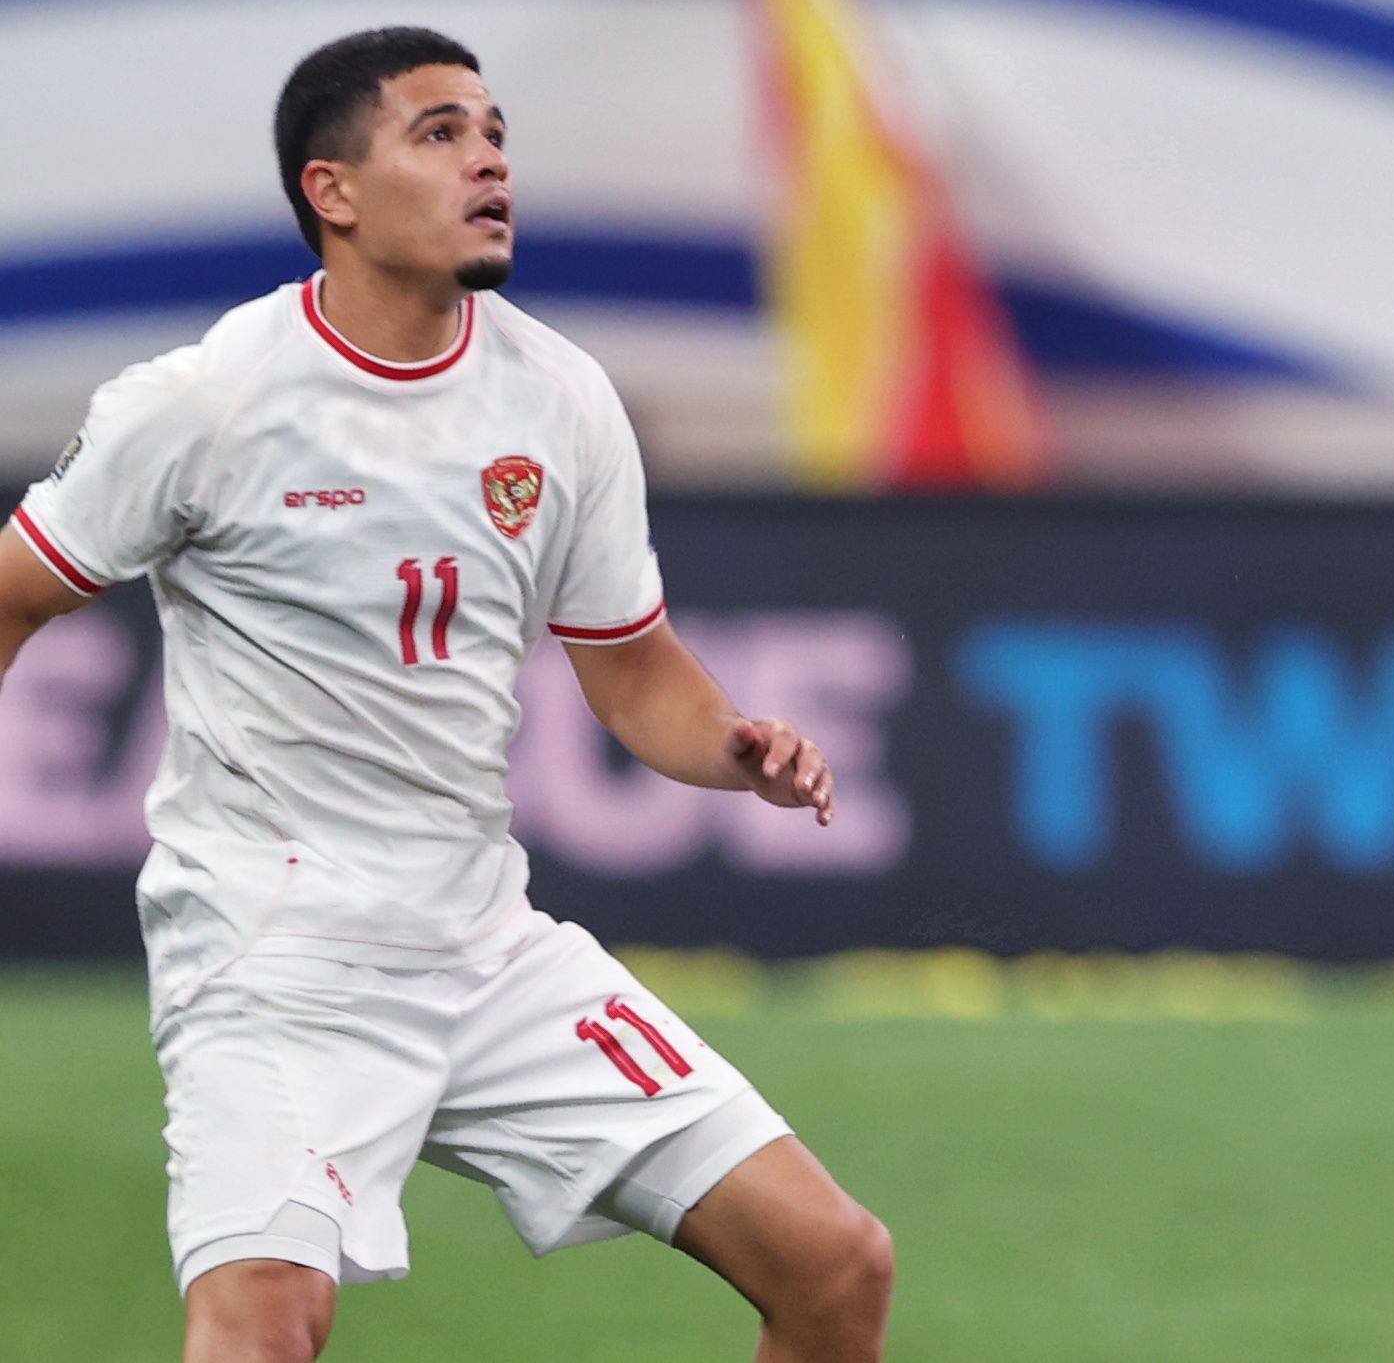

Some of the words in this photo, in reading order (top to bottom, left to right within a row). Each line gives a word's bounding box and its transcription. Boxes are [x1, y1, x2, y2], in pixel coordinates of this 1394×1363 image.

[284, 488, 366, 511] erspo
[396, 556, 459, 666] 11
[576, 995, 694, 1097] 11
